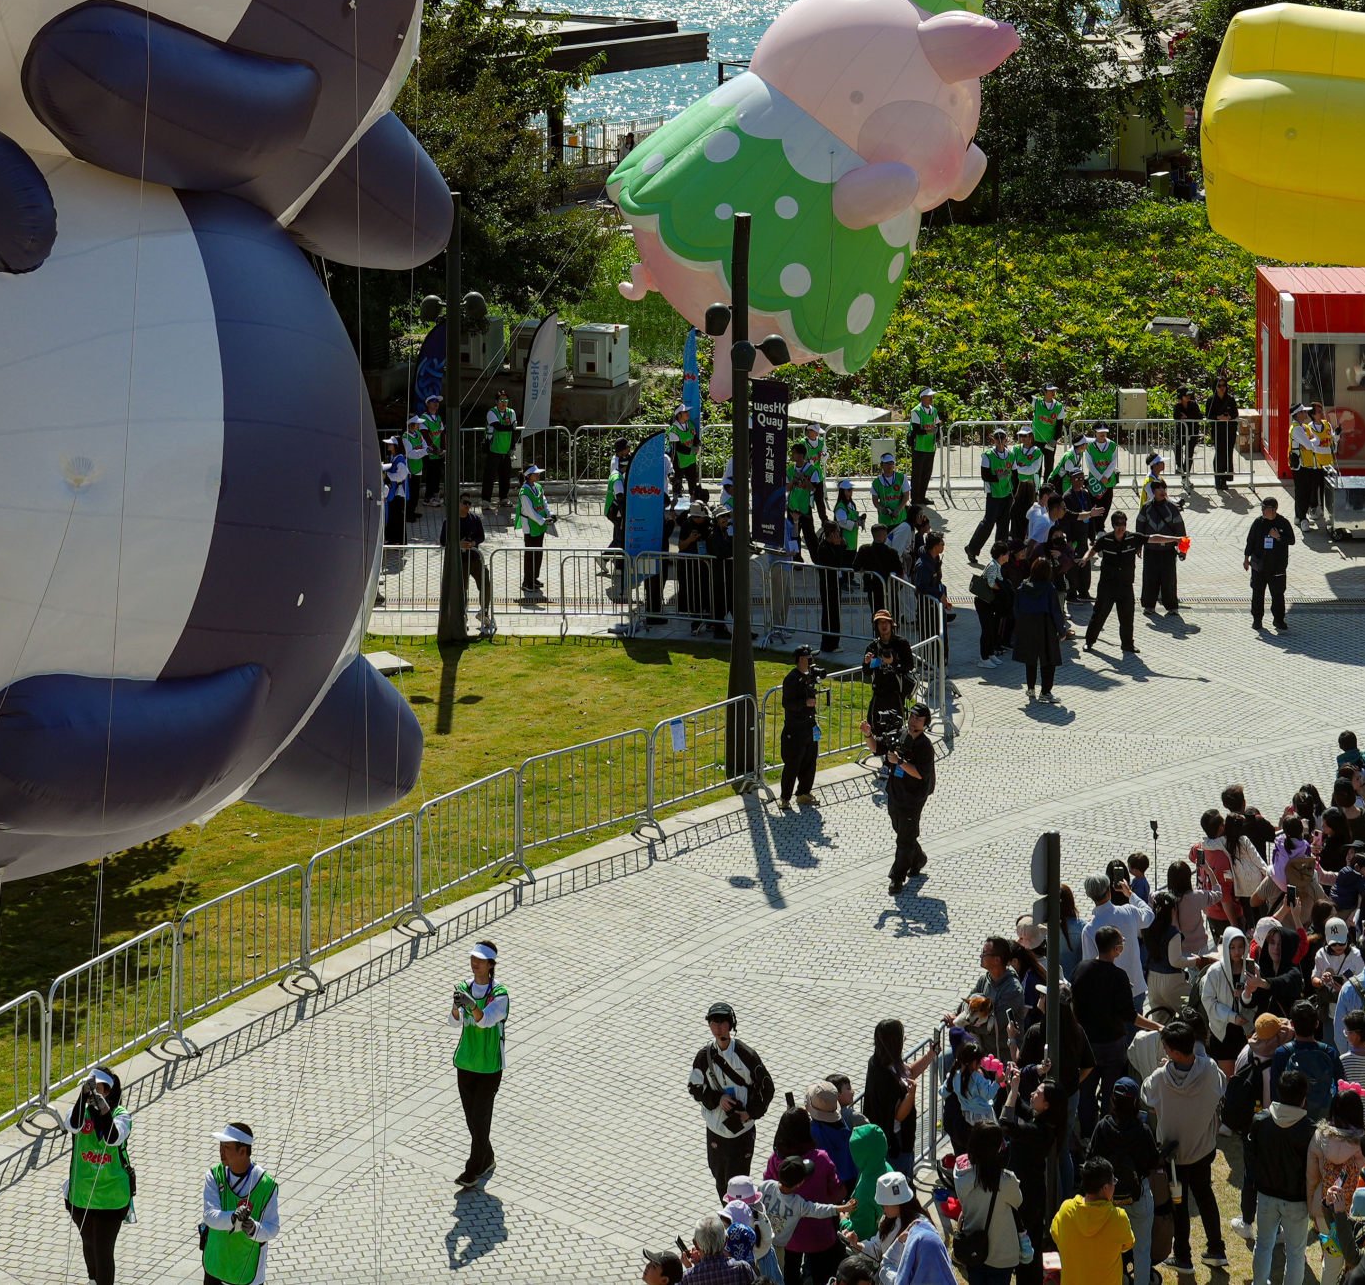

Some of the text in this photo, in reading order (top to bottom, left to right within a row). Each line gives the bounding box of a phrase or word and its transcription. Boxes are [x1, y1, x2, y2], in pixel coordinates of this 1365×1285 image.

[531, 360, 540, 400] westK
[754, 401, 786, 415] westK
[757, 413, 784, 430] Quay
[765, 432, 775, 484] 西九碼頭
[762, 1194, 794, 1217] GAP
